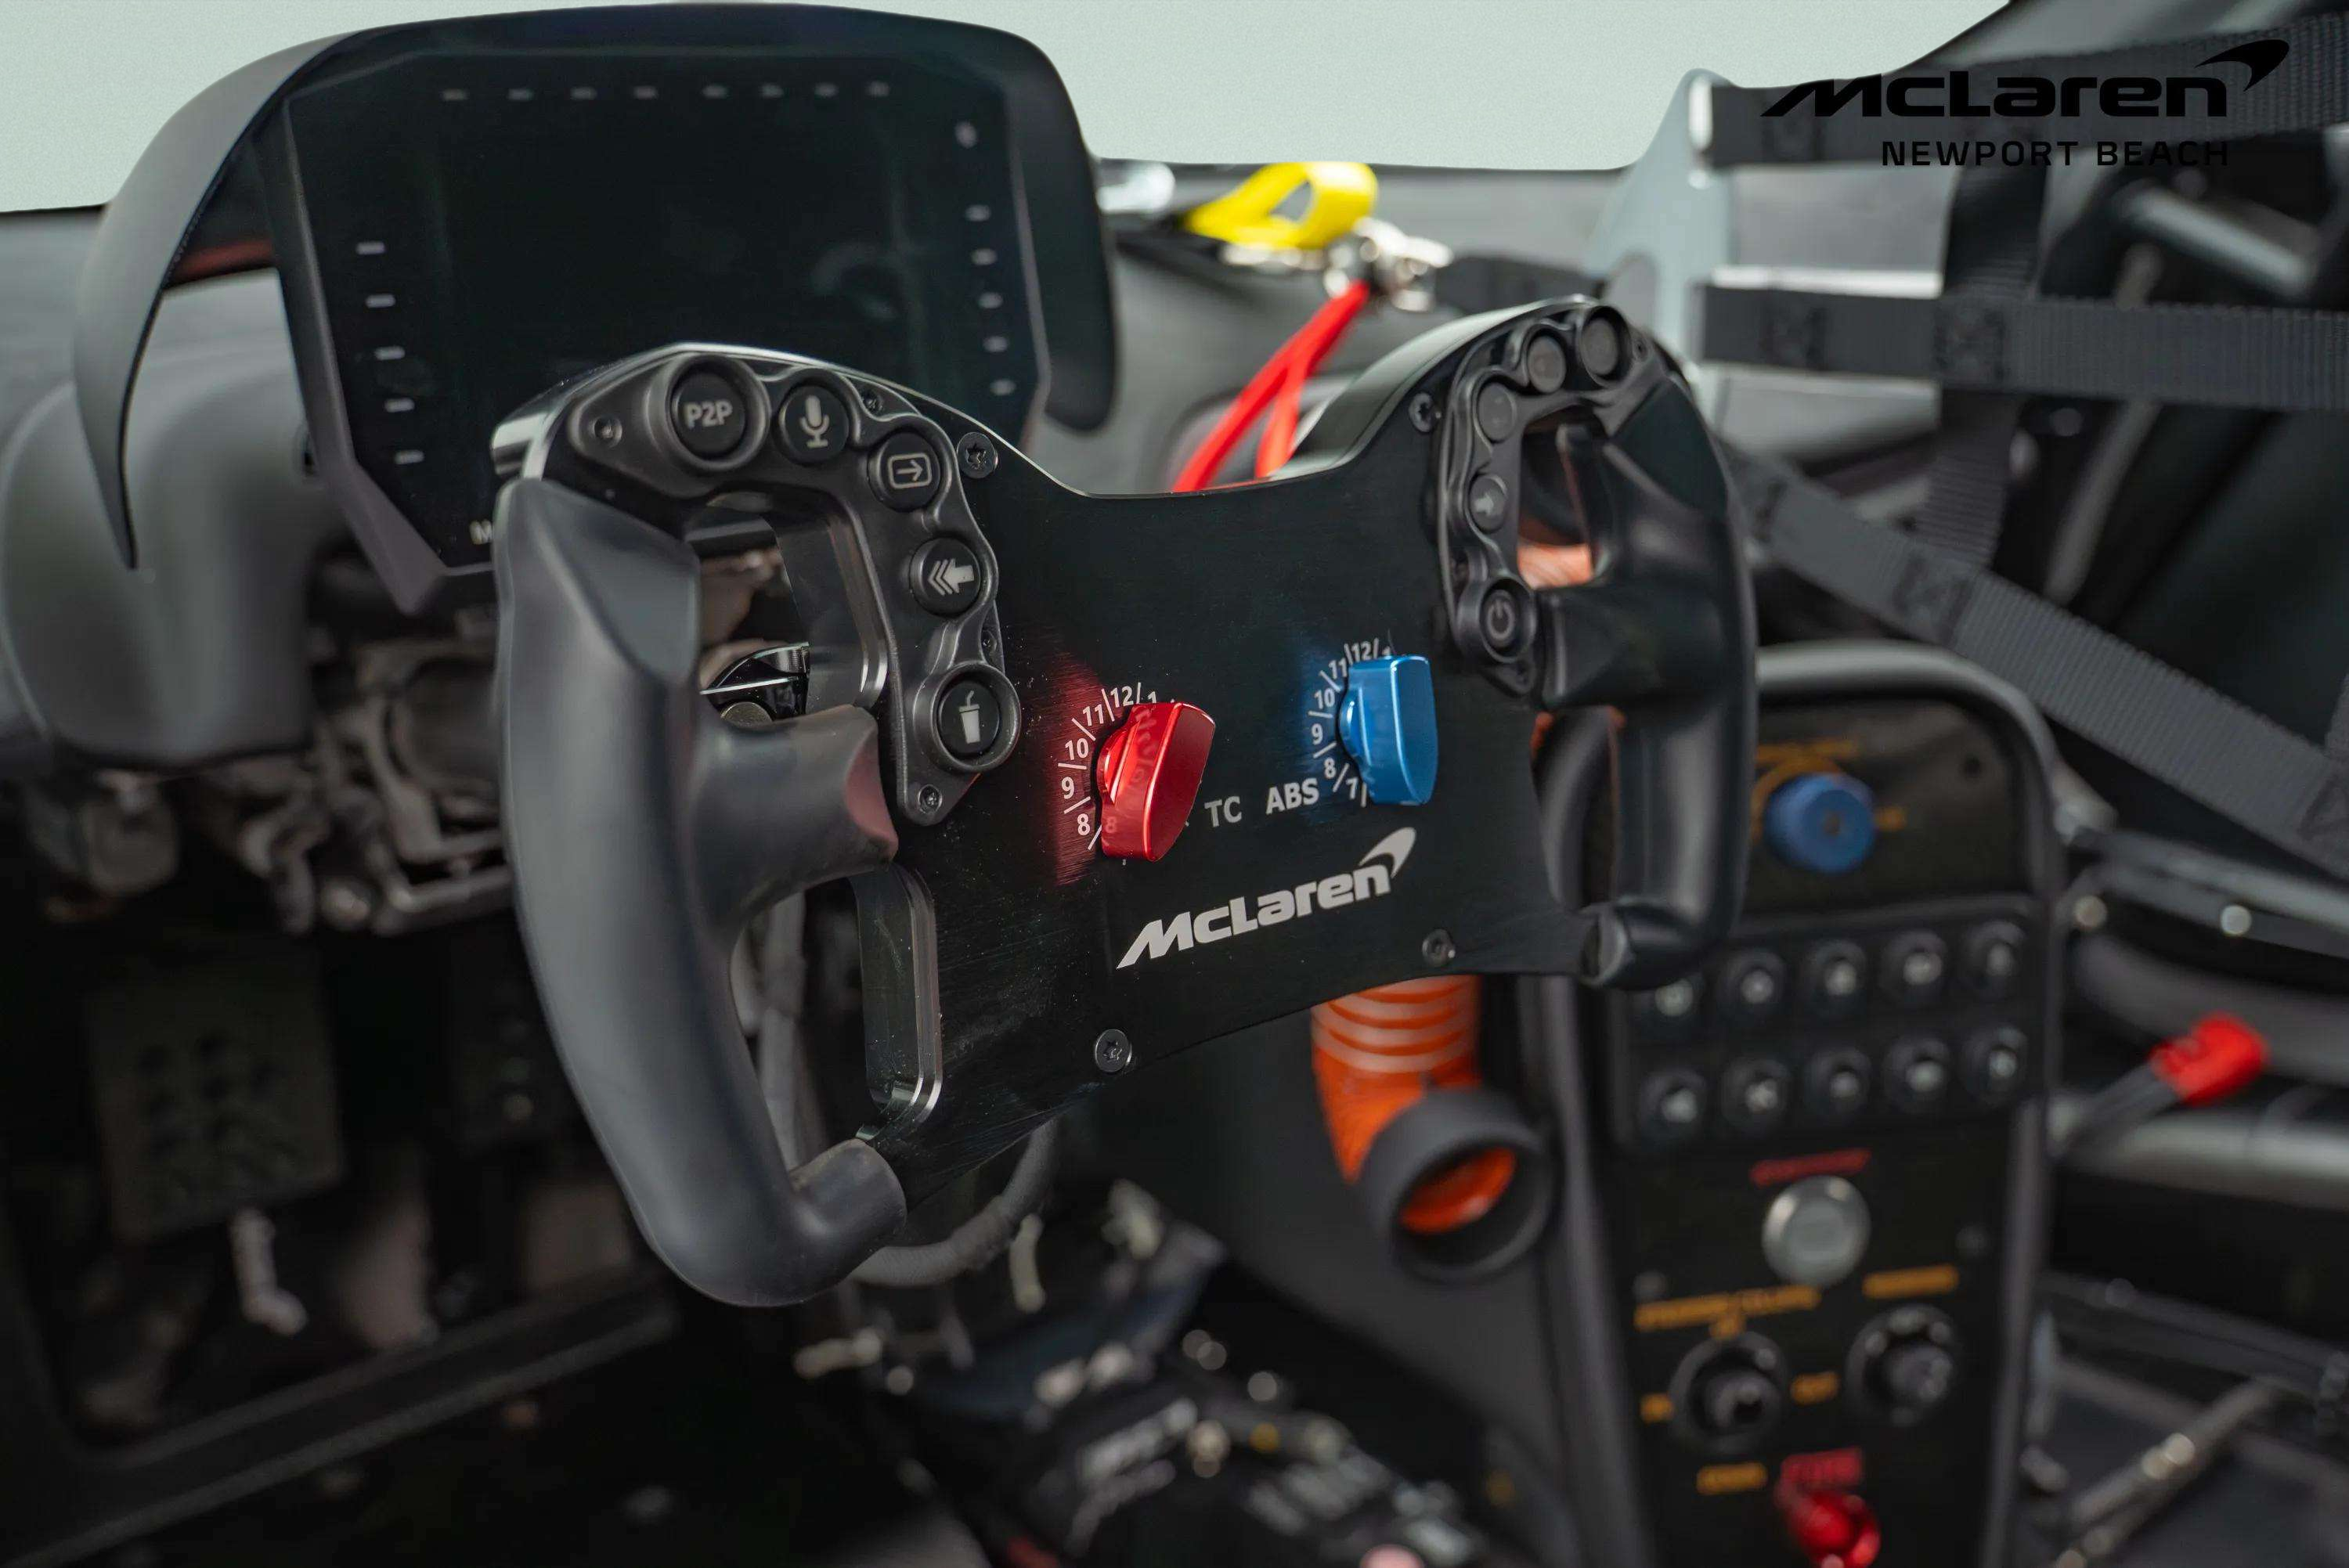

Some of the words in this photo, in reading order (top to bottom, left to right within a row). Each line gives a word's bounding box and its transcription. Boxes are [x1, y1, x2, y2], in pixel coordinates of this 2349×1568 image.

[684, 399, 733, 428] P2P
[1351, 641, 1371, 662] 12
[1329, 658, 1348, 679] 11
[1110, 685, 1134, 707] 12
[1314, 687, 1335, 709] 10
[1082, 704, 1104, 726] 11
[1312, 723, 1323, 744] 9
[1065, 737, 1089, 761] 10
[1323, 758, 1337, 778] 8
[1061, 776, 1075, 799] 9
[1265, 777, 1319, 815] ABS
[1345, 778, 1359, 799] 7
[1204, 795, 1242, 827] TC
[1077, 813, 1091, 835] 8
[1117, 864, 1391, 969] McLaren
